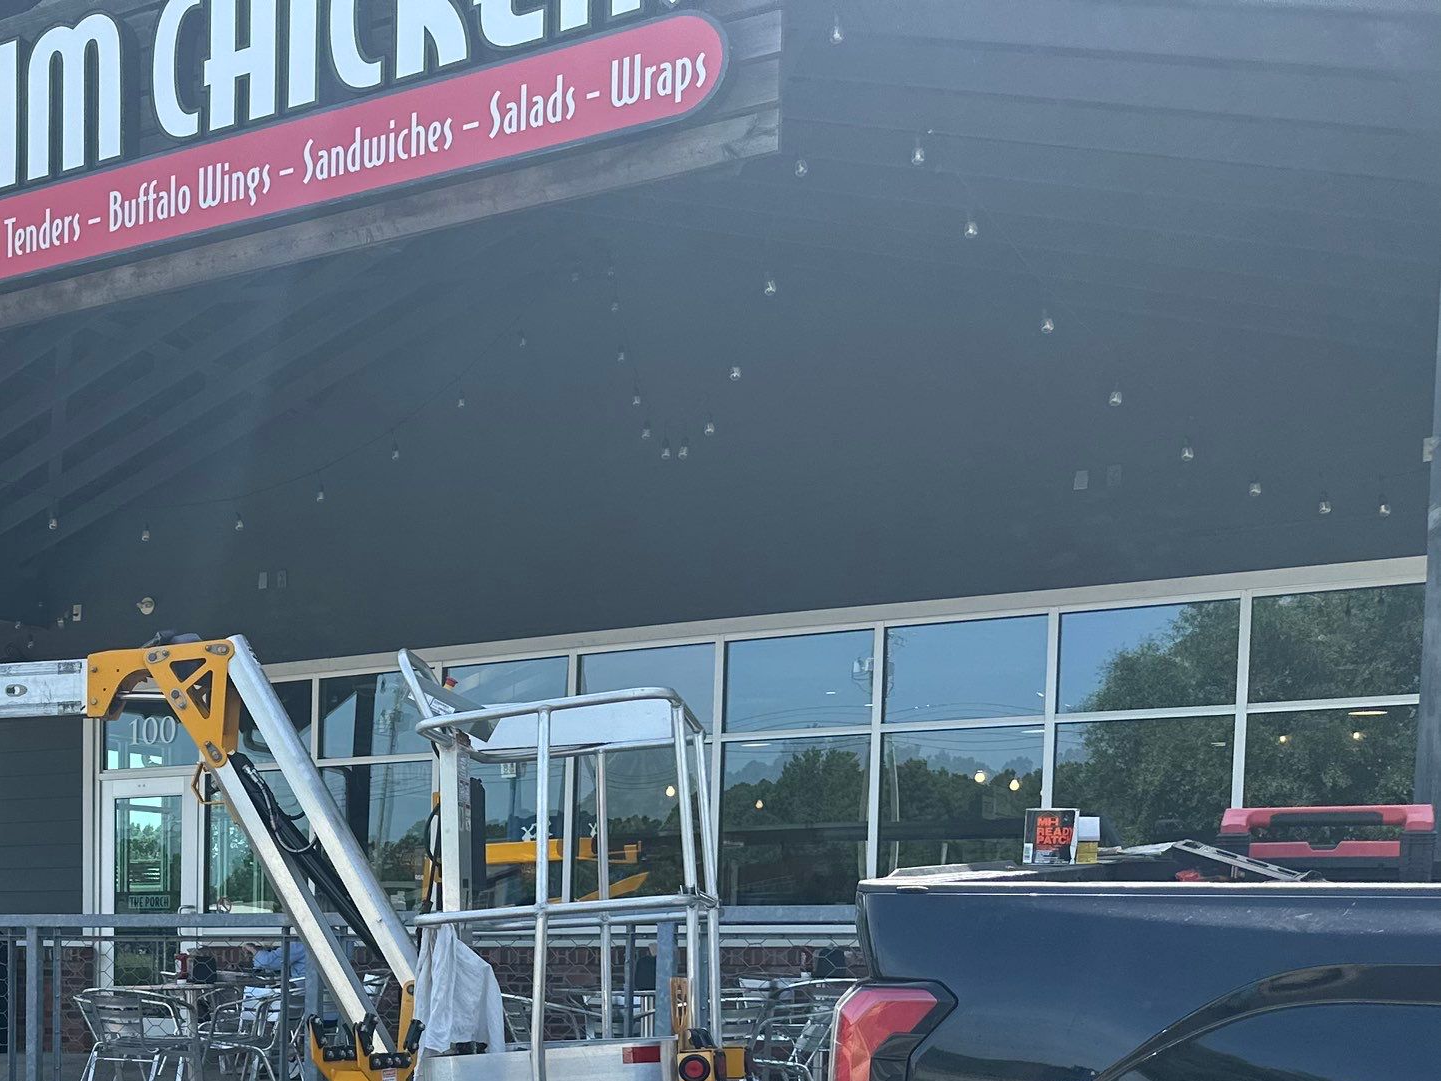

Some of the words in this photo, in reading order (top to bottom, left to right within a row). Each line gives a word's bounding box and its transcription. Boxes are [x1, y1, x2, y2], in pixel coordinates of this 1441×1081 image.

[4, 212, 81, 261] Tenders
[108, 171, 190, 233] Buffalo
[198, 161, 271, 209] Wings
[302, 112, 453, 184] Sandwiches
[488, 74, 576, 139] Salads
[610, 51, 707, 108] Wraps
[129, 715, 176, 746] 100
[130, 896, 144, 908] THE
[145, 896, 169, 908] PORCH
